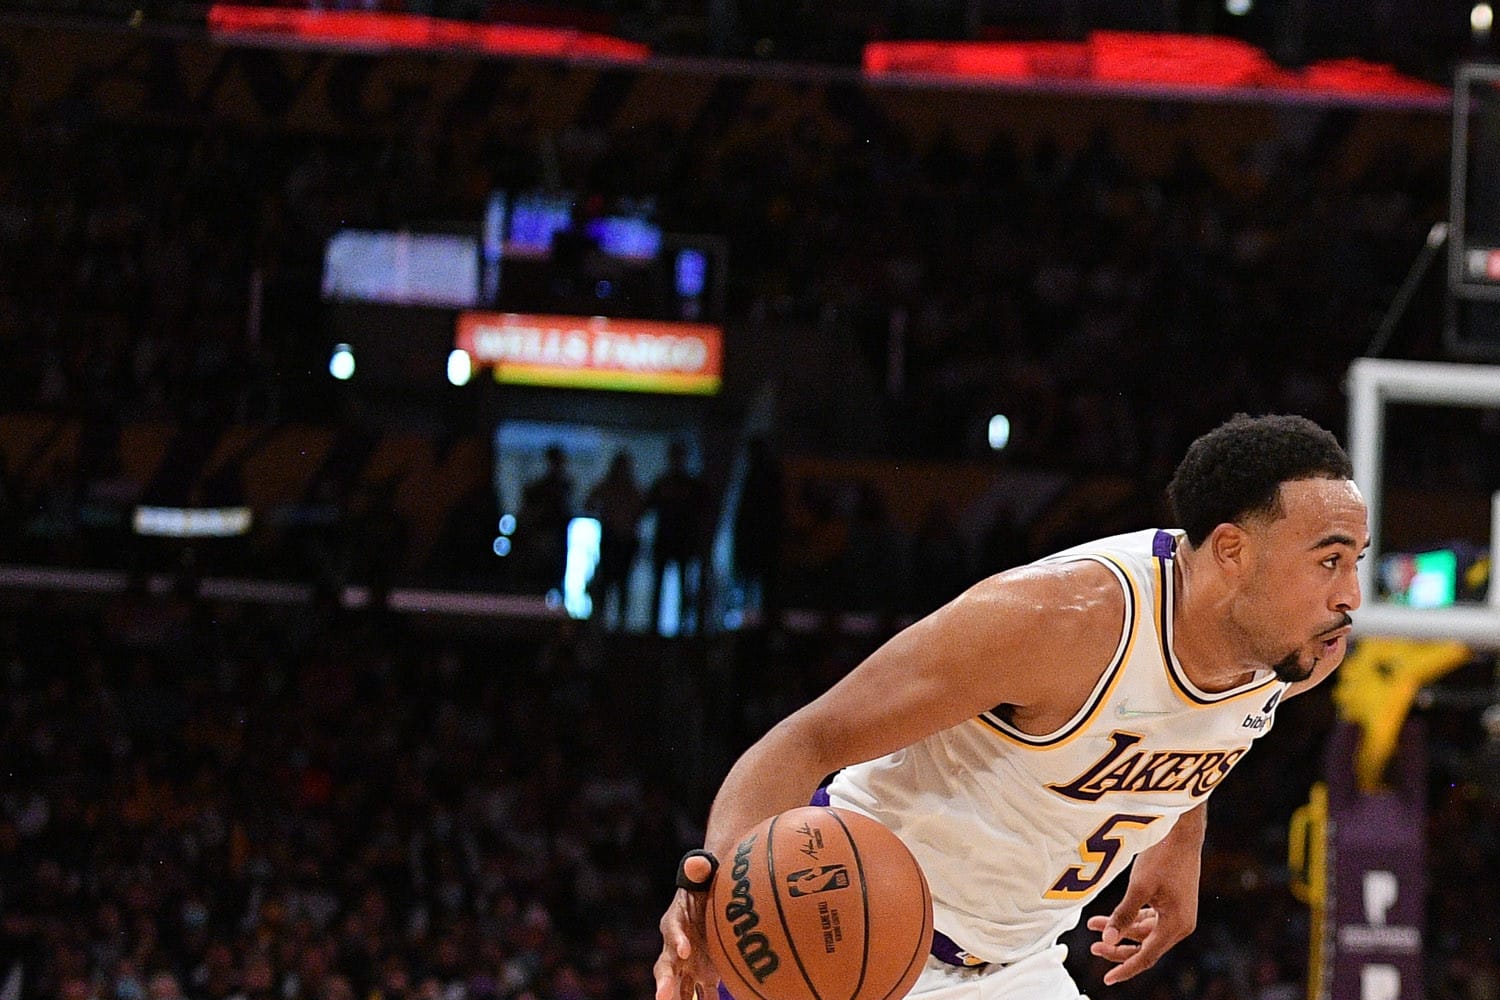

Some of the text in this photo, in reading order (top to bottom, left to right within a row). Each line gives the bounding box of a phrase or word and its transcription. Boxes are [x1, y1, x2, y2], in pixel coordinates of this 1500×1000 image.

[1043, 730, 1248, 804] LAKERS
[1042, 814, 1164, 900] 5
[725, 834, 780, 985] Wilson
